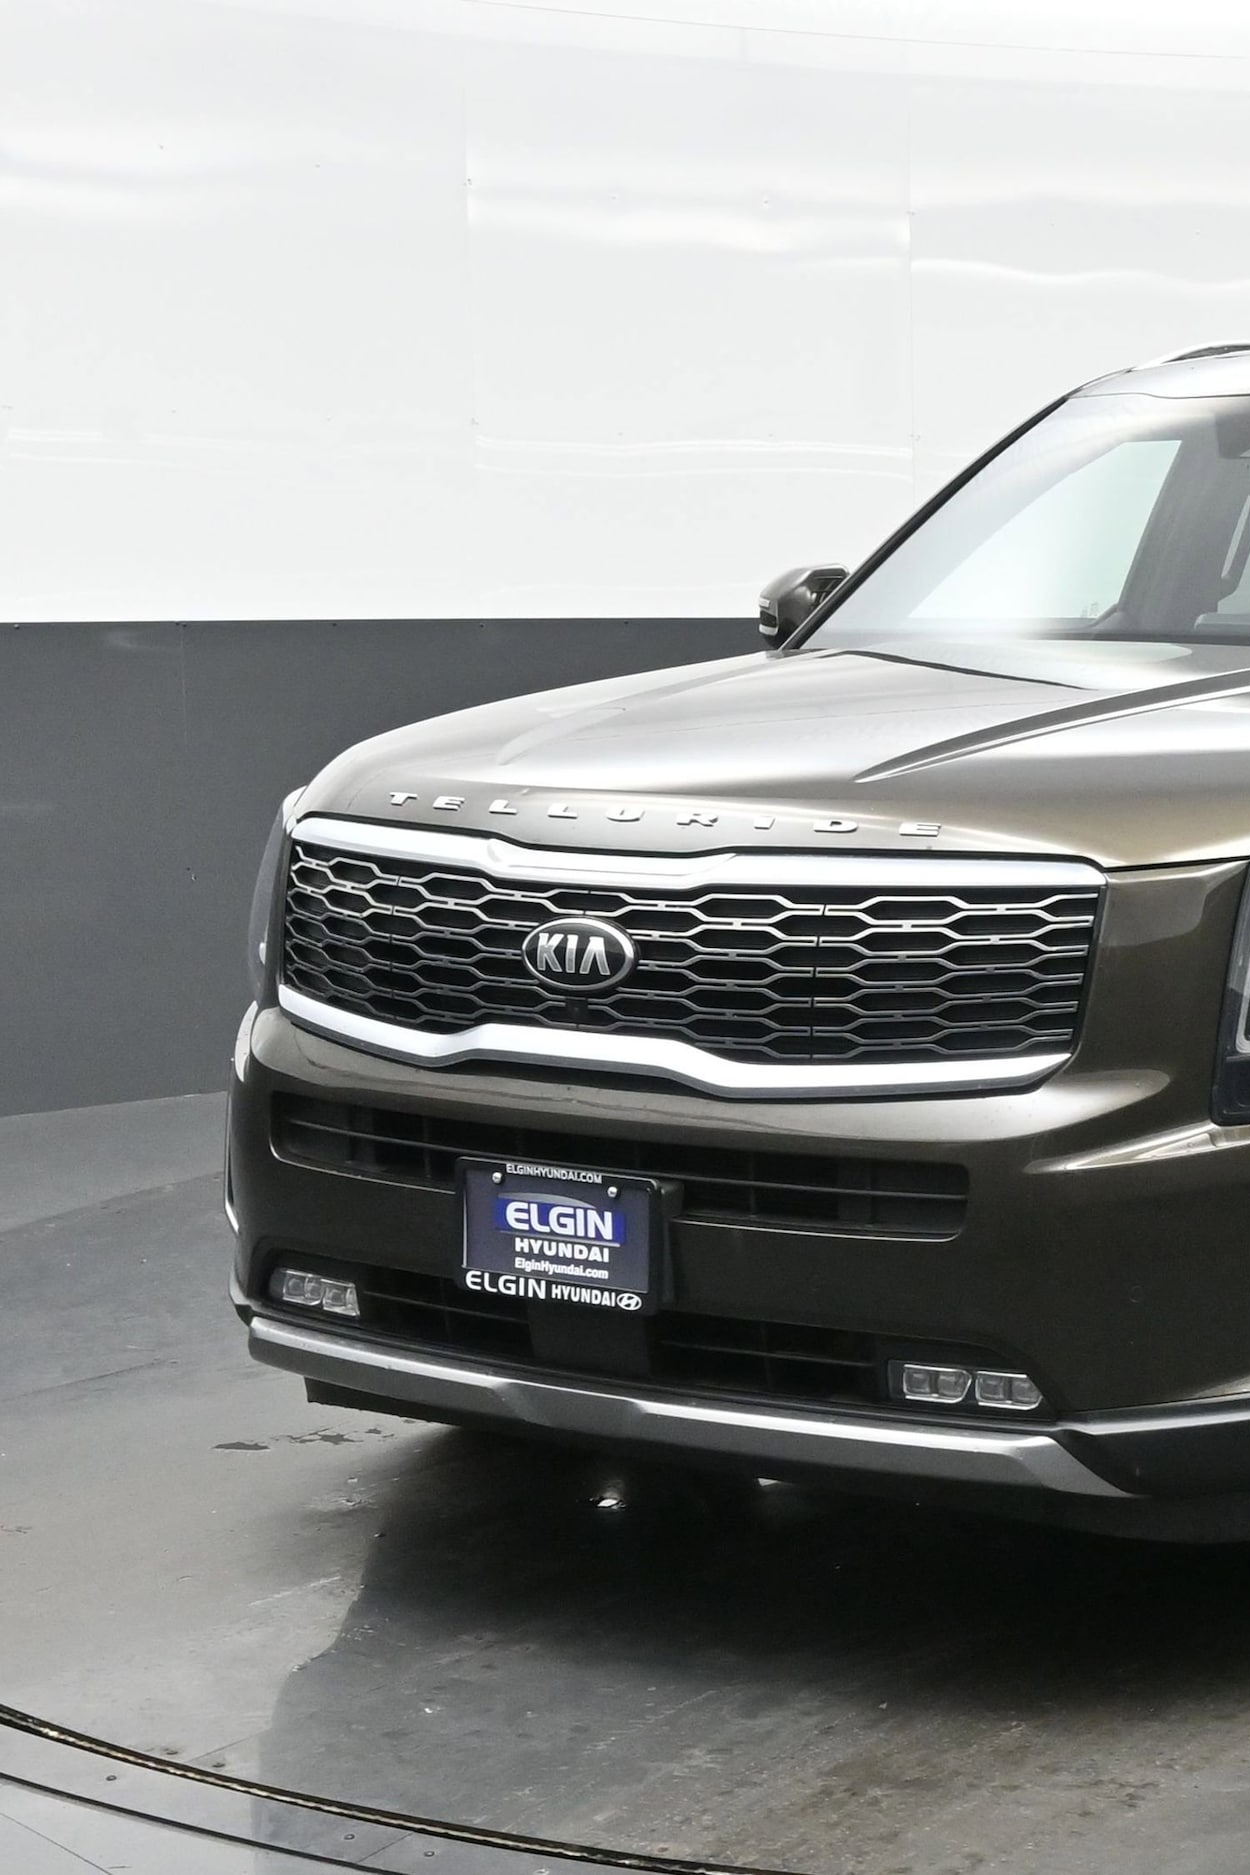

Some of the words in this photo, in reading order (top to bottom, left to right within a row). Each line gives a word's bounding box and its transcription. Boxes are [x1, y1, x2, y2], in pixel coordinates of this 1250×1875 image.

[389, 791, 943, 838] TELLURIDE
[537, 932, 610, 976] KIA
[506, 1163, 602, 1184] ELGINHYUNDAI.COM
[506, 1201, 613, 1240] ELGIN
[514, 1237, 610, 1263] HYUNDAI
[514, 1257, 609, 1279] ElginHyundai.com
[465, 1270, 546, 1300] ELGIN
[551, 1284, 616, 1307] HYUNDAI
